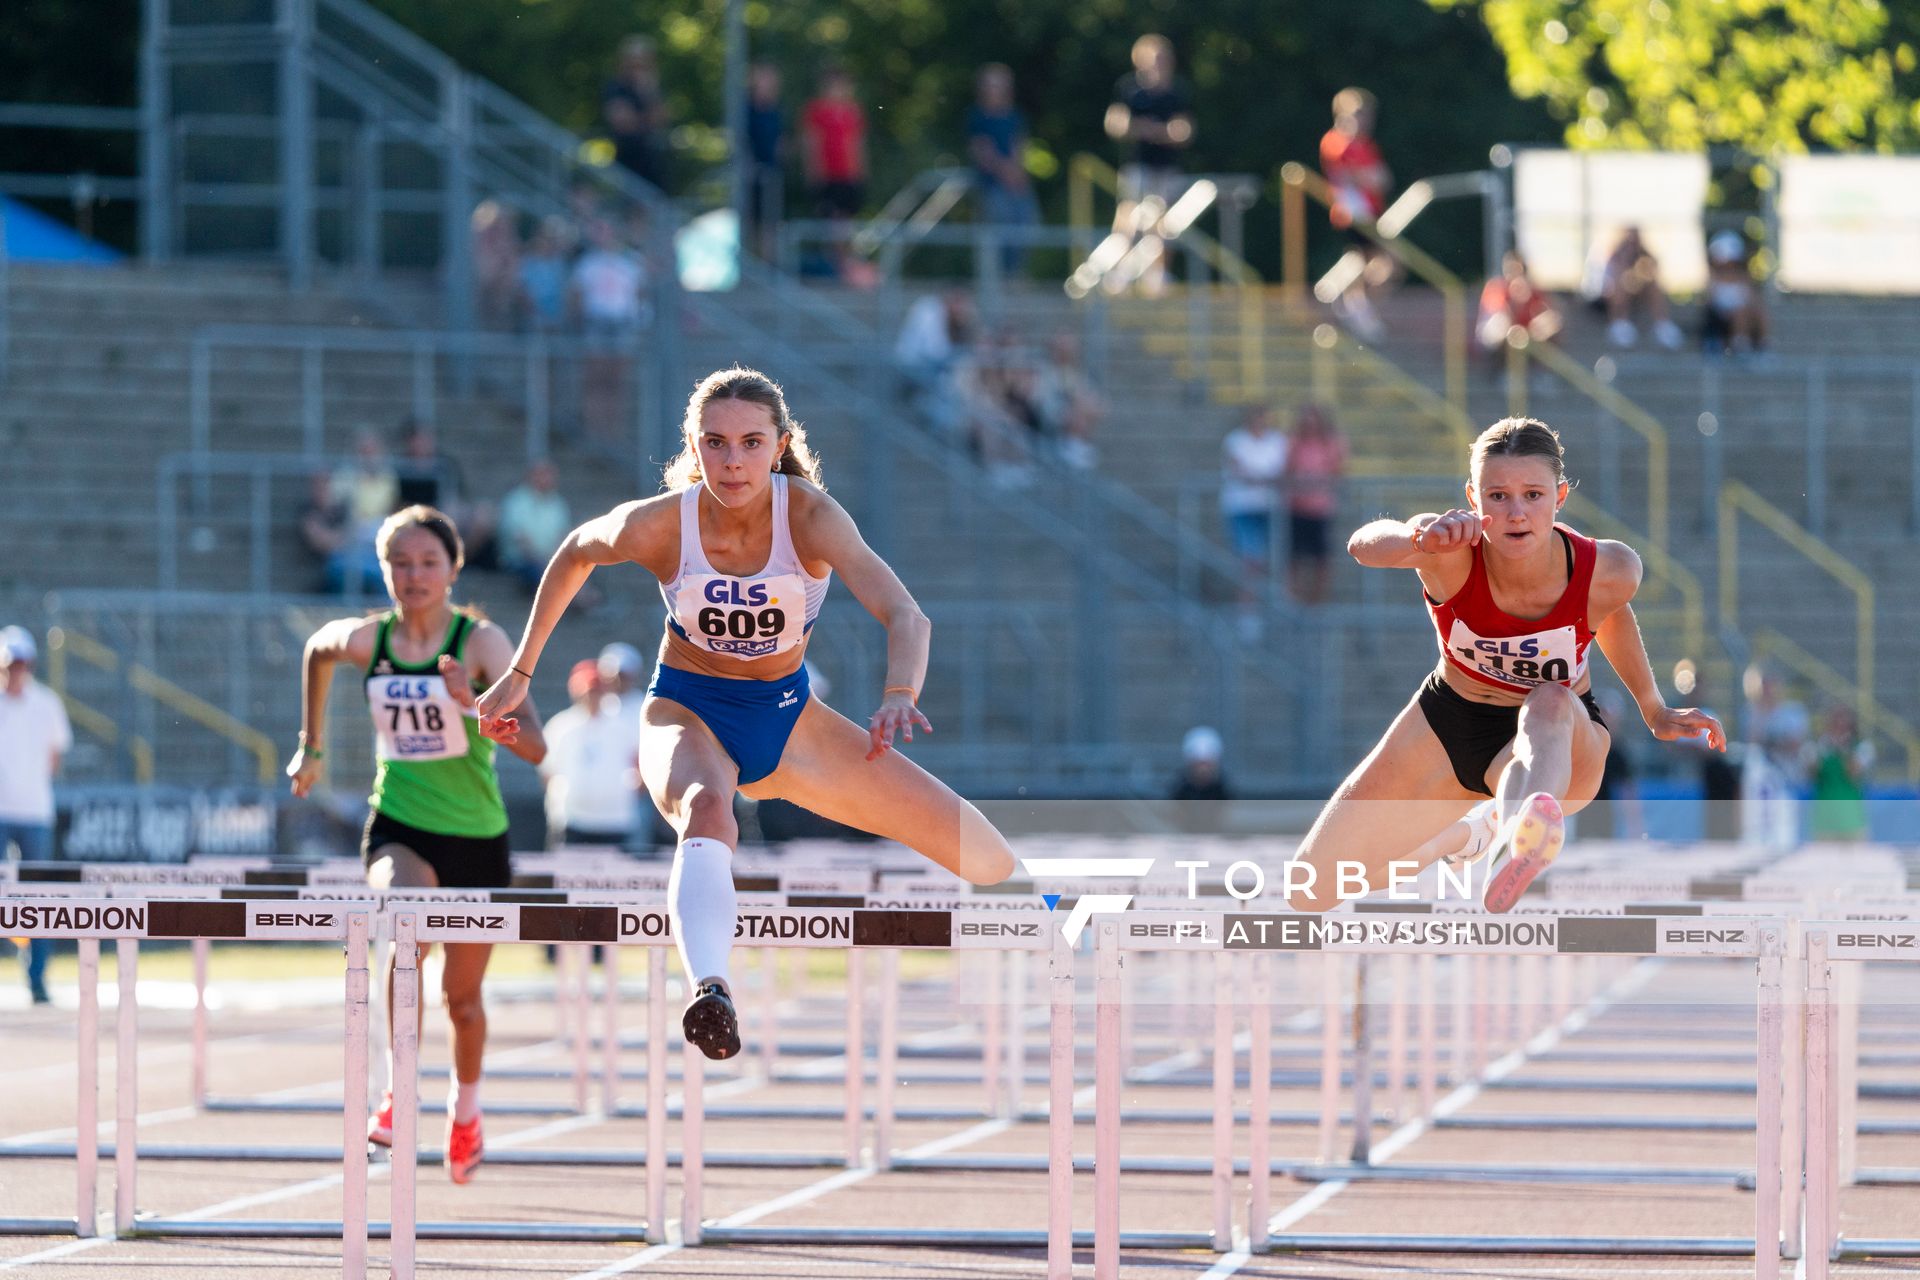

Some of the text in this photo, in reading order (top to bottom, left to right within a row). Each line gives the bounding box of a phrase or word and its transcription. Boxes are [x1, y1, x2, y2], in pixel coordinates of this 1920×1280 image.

[698, 607, 785, 639] 609
[737, 640, 776, 651] PLAN
[384, 704, 444, 732] 718
